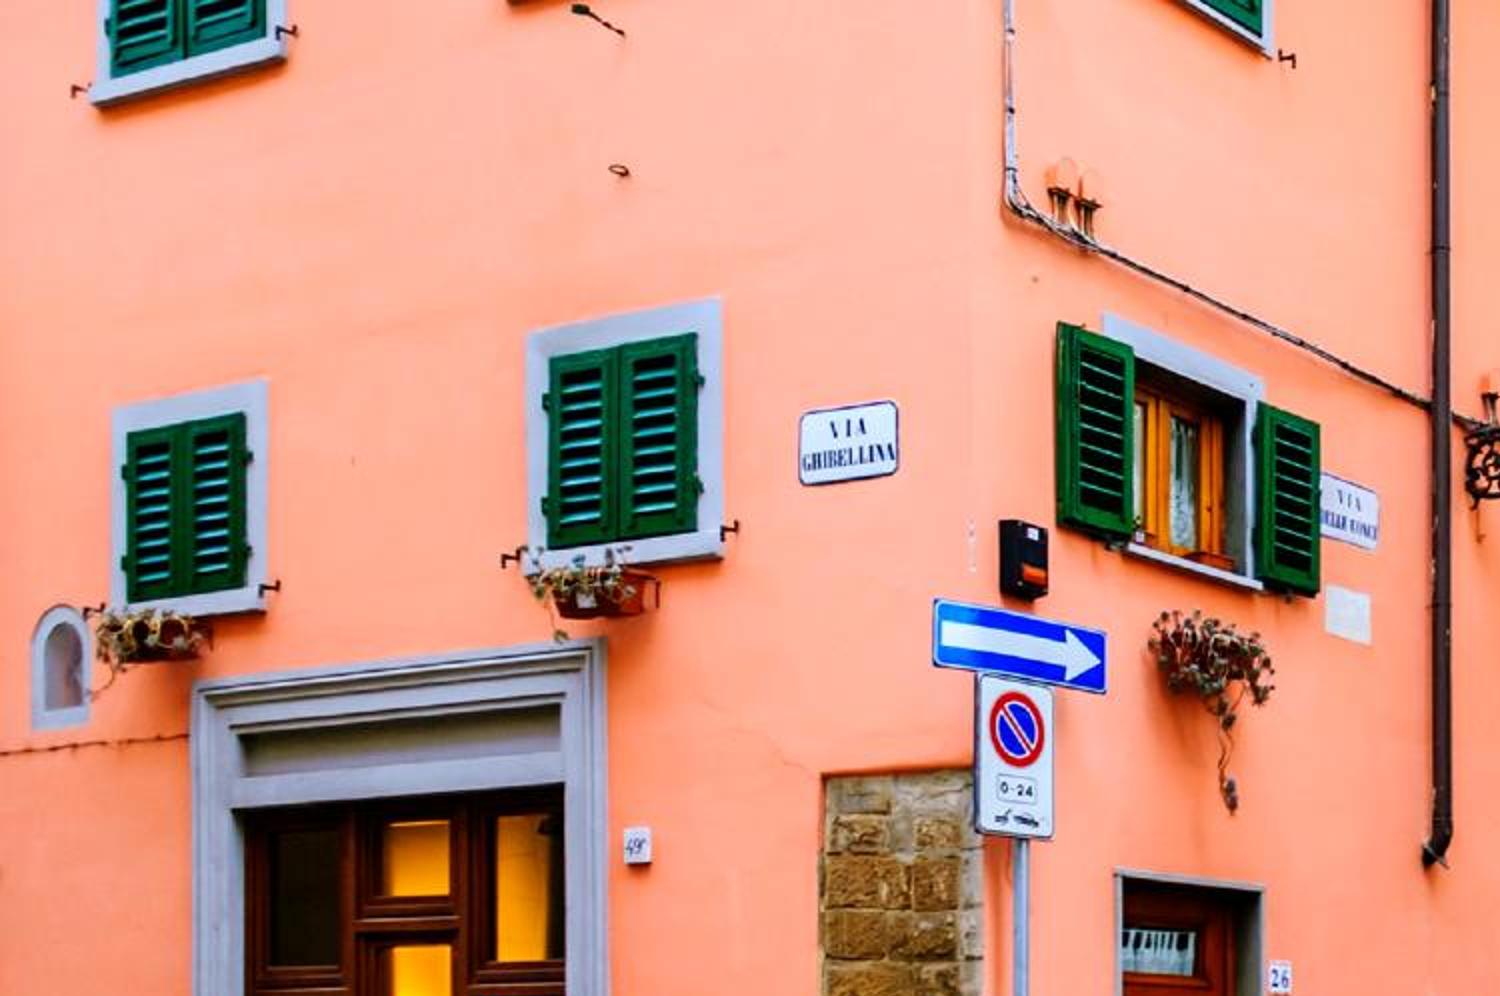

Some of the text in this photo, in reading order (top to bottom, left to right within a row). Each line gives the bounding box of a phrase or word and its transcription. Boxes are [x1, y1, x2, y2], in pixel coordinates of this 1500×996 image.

[830, 417, 867, 439] VIA
[803, 442, 896, 471] GHIBELLINA
[1336, 489, 1362, 513] VIA
[1000, 781, 1034, 798] 0-24
[1271, 967, 1290, 989] 26
